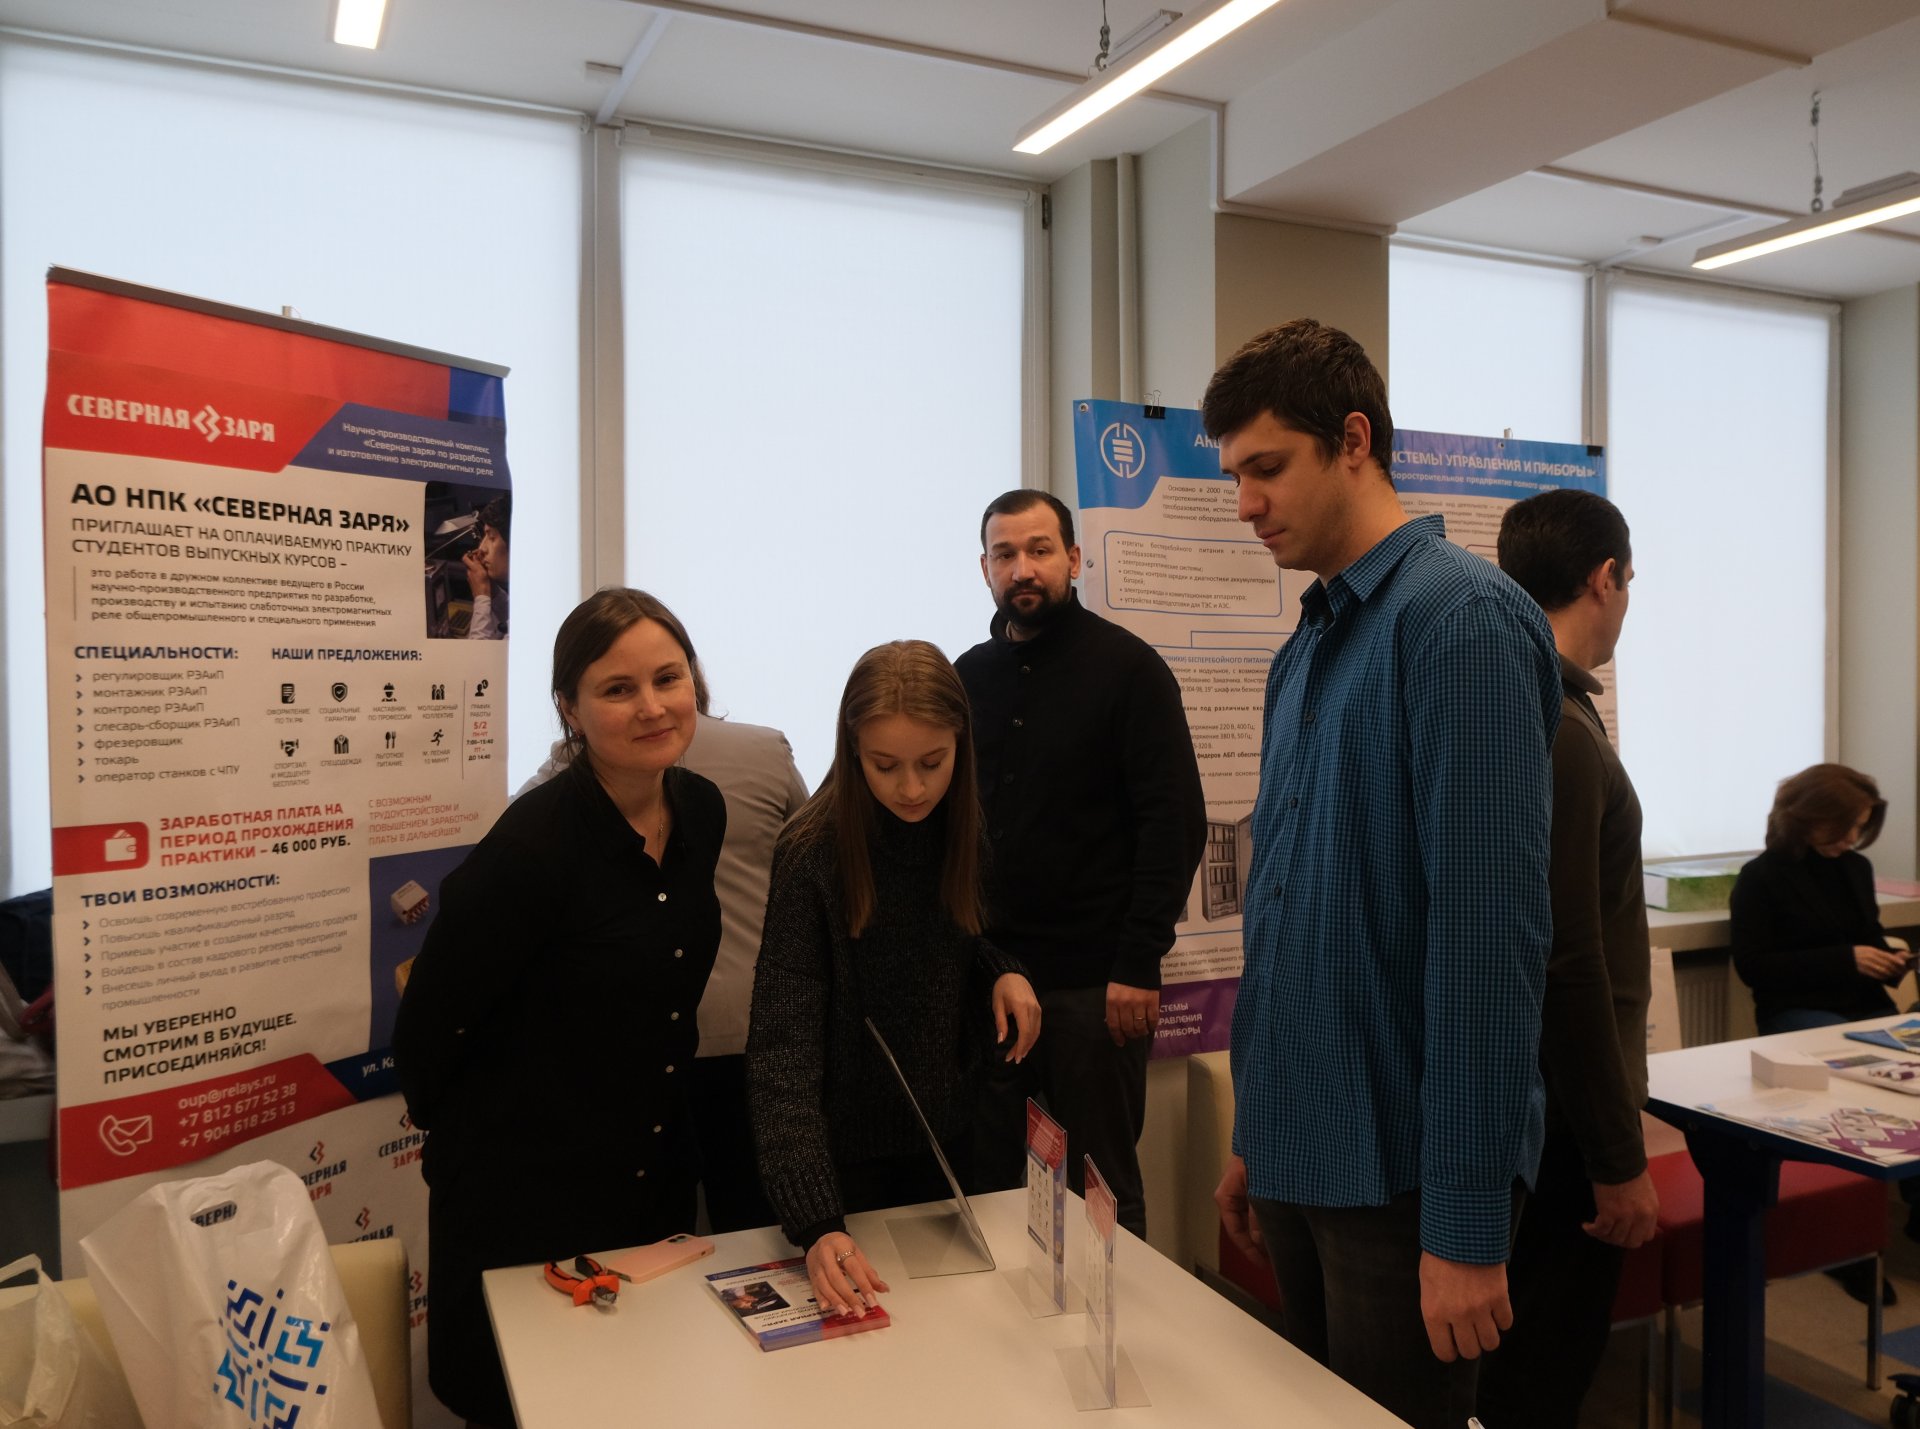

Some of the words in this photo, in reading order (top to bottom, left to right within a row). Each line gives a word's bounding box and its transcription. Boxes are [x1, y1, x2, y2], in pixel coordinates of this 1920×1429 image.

[67, 394, 190, 429] СЕВЕРНАЯ
[224, 416, 275, 442] ЗАРЯ
[343, 423, 453, 448] Научно-производственный
[455, 442, 490, 454] комплекс
[336, 450, 399, 463] изготовлению
[401, 457, 474, 473] электромагнитных
[476, 467, 493, 476] реле
[363, 439, 410, 453] «Северная
[412, 446, 436, 457] заря»
[438, 451, 447, 460] по
[450, 452, 493, 465] разработке
[1447, 454, 1521, 471] УПРАВЛЕНИЯ
[1524, 461, 1532, 471] И
[1392, 471, 1464, 484] боростроительное
[1466, 476, 1513, 487] предприятие
[71, 484, 116, 506] АО
[126, 487, 187, 512] НПК
[194, 496, 332, 527] «СЕВЕРНАЯ
[339, 510, 410, 532] ЗАРЯ»
[72, 518, 194, 538] ПРИГЛАШАЕТ
[198, 527, 220, 541] НА
[223, 529, 343, 551] ОПЛАЧИВАЕМУЮ
[347, 540, 412, 557] ПРАКТИКУ
[72, 539, 181, 557] СТУДЕНТОВ
[185, 545, 281, 565] ВЫПУСКНЫХ
[285, 553, 336, 569] КУРСОВ
[91, 569, 111, 578] это
[115, 569, 156, 580] работа
[160, 572, 167, 580] в
[170, 572, 219, 582] дружном
[222, 576, 278, 586] коллективе
[280, 580, 325, 592] ведущего
[335, 581, 365, 591] России
[91, 583, 246, 597] научно-производственного
[249, 590, 309, 602] предприятия
[311, 594, 322, 602] по
[324, 594, 376, 605] разработке,
[91, 597, 177, 609] производству
[190, 601, 247, 610] испытанию
[250, 602, 309, 612] слаботочных
[312, 606, 392, 616] электромагнитных
[92, 611, 122, 621] реле
[125, 611, 246, 623] общепромышленного
[258, 616, 321, 626] специального
[323, 618, 376, 627] применения
[74, 646, 239, 661] СПЕЦИАЛЬНОСТИ:
[271, 648, 314, 660] НАШИ
[317, 649, 423, 662] ПРЕДЛОЖЕНИЯ:
[92, 671, 184, 683] регулировщик
[186, 670, 224, 680] РЭАиП
[93, 689, 165, 698] монтажник
[168, 686, 208, 696] РЭАиП
[93, 705, 161, 715] контролер
[164, 703, 205, 713] РЭАиП
[94, 719, 201, 732] слесарь-сборщик
[204, 717, 240, 727] РЭАиП
[473, 721, 487, 729] 5/2
[94, 737, 184, 750] фрезеровщик
[94, 756, 140, 766] токарь
[94, 770, 155, 784] оператор
[159, 768, 206, 779] станков
[209, 768, 215, 776] с
[217, 765, 240, 775] ЧПУ
[368, 800, 374, 808] С
[376, 794, 432, 808] ВОЗМОЖНЫМ
[369, 804, 452, 820] ТРУДОУСТРОЙСТВОМ
[159, 810, 273, 831] ЗАРАБОТНАЯ
[277, 806, 322, 821] ПЛАТА
[325, 803, 343, 816] НА
[369, 819, 428, 833] ПОВЫШЕНИЕМ
[430, 812, 479, 826] ЗАРАБОТНОЙ
[160, 831, 237, 849] ПЕРИОД
[240, 818, 354, 841] ПРОХОЖДЕНИЯ
[369, 835, 397, 845] ПЛАТЫ
[407, 826, 461, 842] ДАЛЬНЕЙШЕМ
[160, 846, 256, 867] ПРАКТИКИ
[271, 841, 289, 855] 46
[291, 838, 317, 852] 000
[320, 835, 351, 849] РУБ.
[81, 889, 136, 908] ТВОИ
[142, 874, 280, 901] ВОЗМОЖНОСТИ:
[99, 915, 153, 928] Освоишь
[155, 906, 228, 921] современную
[231, 894, 305, 912] востребованную
[306, 886, 351, 899] профессию
[100, 931, 161, 944] Повысишь
[164, 914, 262, 936] квалификационный
[264, 910, 295, 923] разряд
[101, 947, 156, 961] Примешь
[158, 940, 201, 954] участие
[204, 939, 210, 947] в
[212, 931, 257, 945] создании
[260, 921, 320, 937] качественного
[322, 913, 358, 926] продукта
[101, 964, 154, 977] Войдешь
[168, 956, 203, 968] состав
[206, 947, 256, 961] кадрового
[258, 940, 294, 954] резерва
[296, 930, 347, 946] предприятия
[101, 980, 153, 994] Внесешь
[156, 972, 197, 986] личный
[199, 967, 229, 979] вклад
[230, 966, 236, 974] в
[239, 958, 280, 973] развитие
[282, 944, 342, 963] отечественной
[101, 988, 200, 1011] промышленности
[1160, 1003, 1189, 1013] СТЕМЫ
[103, 1024, 137, 1042] МЫ
[143, 1006, 236, 1036] УВЕРЕННО
[1158, 1013, 1202, 1026] РАВЛЕНИЯ
[103, 1034, 198, 1063] СМОТРИМ
[204, 1031, 214, 1043] В
[220, 1013, 297, 1041] БУДУЩЕЕ.
[1160, 1026, 1200, 1038] ПРИБОРЫ
[104, 1039, 267, 1085] ПРИСОЕДИНЯЙСЯ!
[362, 1063, 379, 1078] ул.
[382, 1056, 395, 1069] Ка
[178, 1074, 277, 1111] oup@relays.ru
[179, 1113, 198, 1128] +7
[203, 1104, 231, 1123] 812
[235, 1096, 260, 1114] 677
[263, 1089, 278, 1105] 52
[281, 1083, 297, 1100] 38
[179, 1134, 199, 1148] +7
[203, 1124, 230, 1143] 904
[233, 1114, 258, 1133] 618
[261, 1109, 277, 1126] 25
[280, 1101, 296, 1116] 13
[379, 1131, 429, 1158] СЕВЕРН
[301, 1160, 347, 1185] ВЕРНАЯ
[310, 1182, 332, 1200] АРЯ
